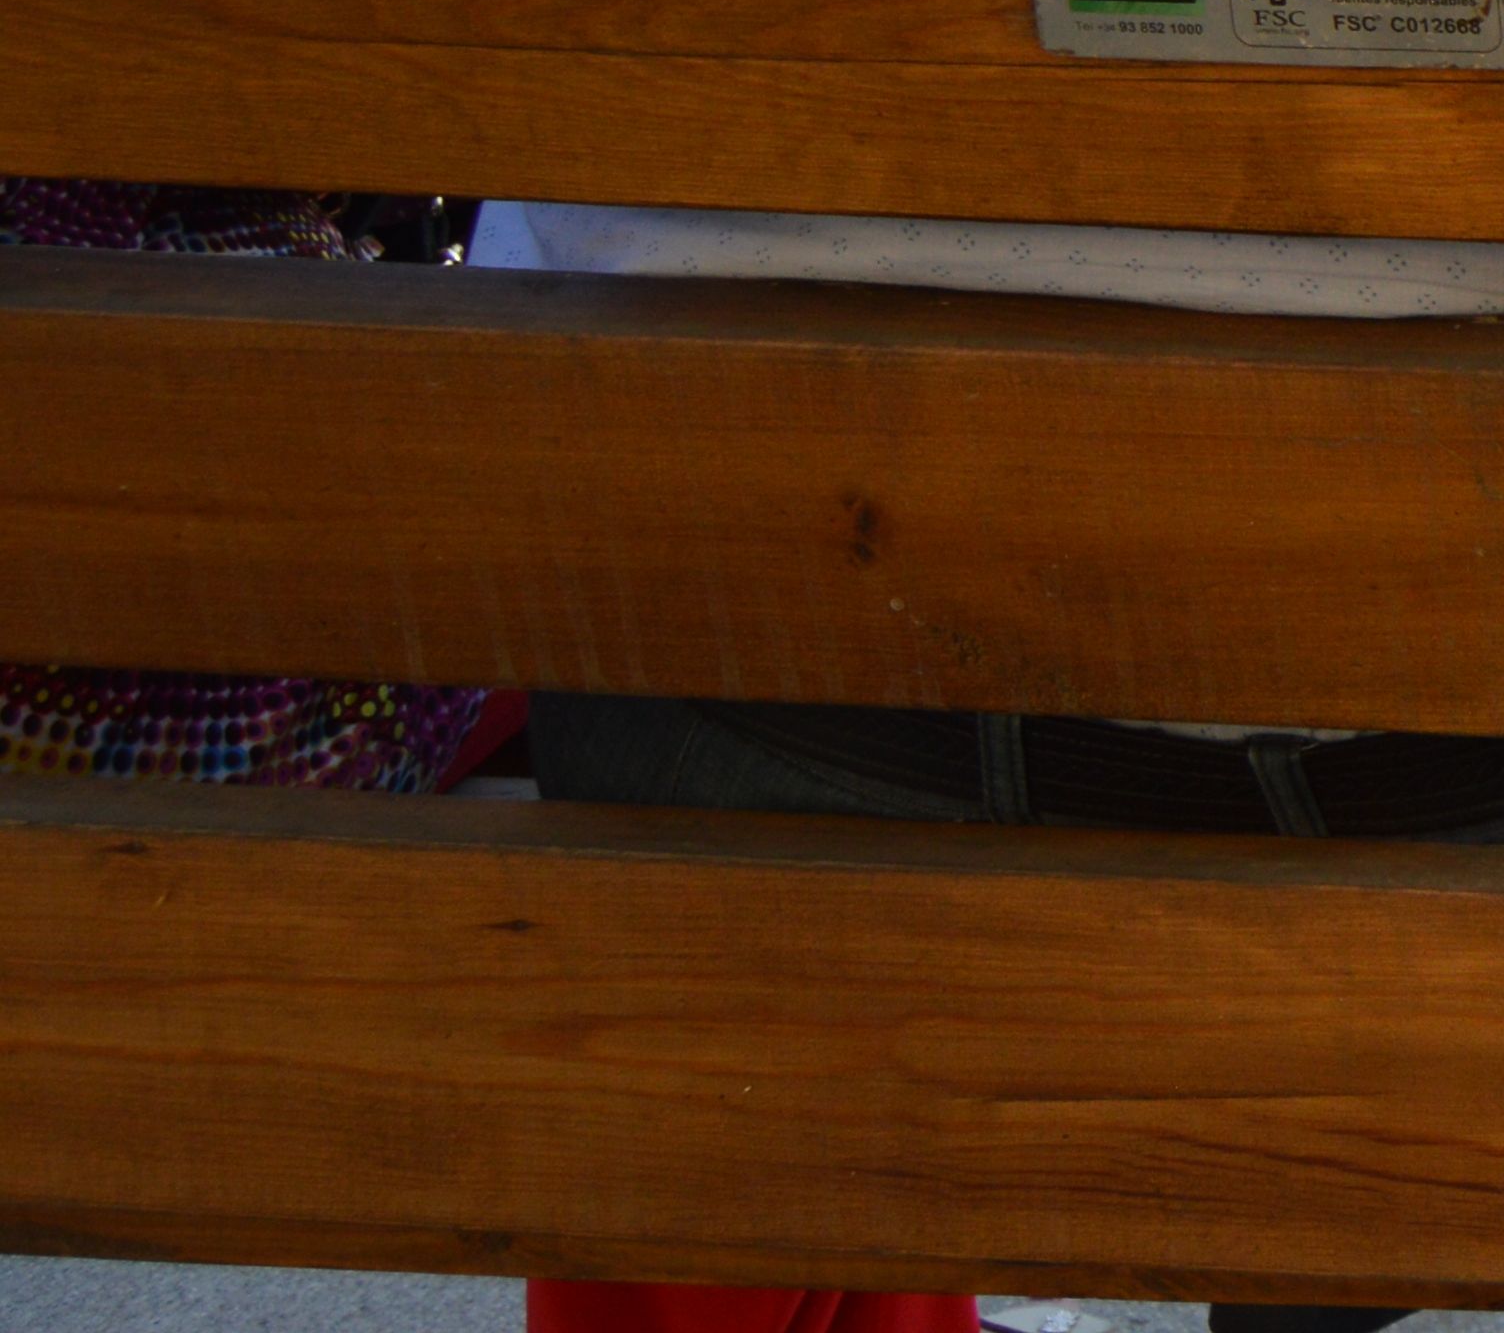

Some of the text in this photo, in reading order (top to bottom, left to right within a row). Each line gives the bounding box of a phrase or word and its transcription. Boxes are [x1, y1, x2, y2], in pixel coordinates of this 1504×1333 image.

[1253, 9, 1306, 27] FSC
[1118, 21, 1137, 33] 93
[1140, 21, 1165, 33] 852
[1169, 22, 1203, 35] 1000
